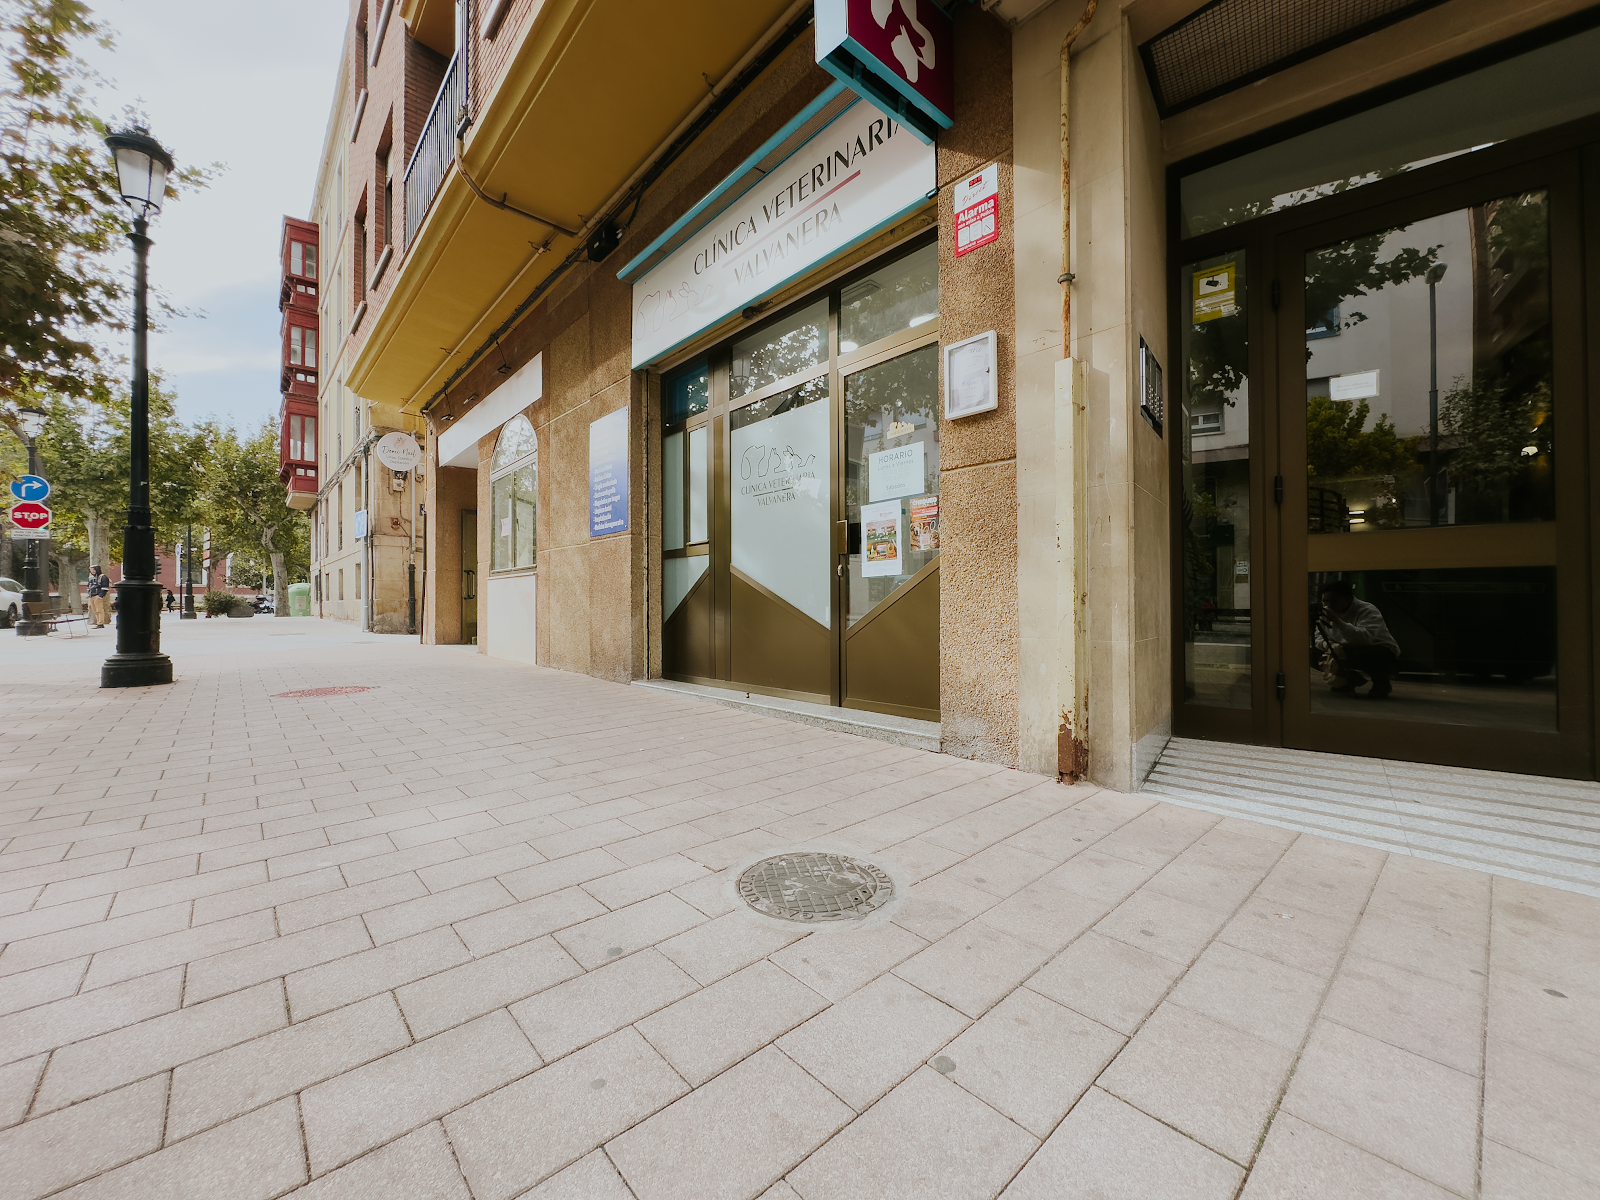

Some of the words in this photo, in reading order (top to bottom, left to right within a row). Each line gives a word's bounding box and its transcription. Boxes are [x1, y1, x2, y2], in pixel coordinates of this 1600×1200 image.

[957, 198, 995, 224] Alarma
[694, 215, 757, 275] CLÍNICA
[734, 201, 843, 287] VALVANERA
[879, 449, 912, 464] HORARIO
[741, 482, 767, 496] CLÍNICA
[757, 492, 796, 507] VALVANERA
[14, 511, 47, 520] STOP
